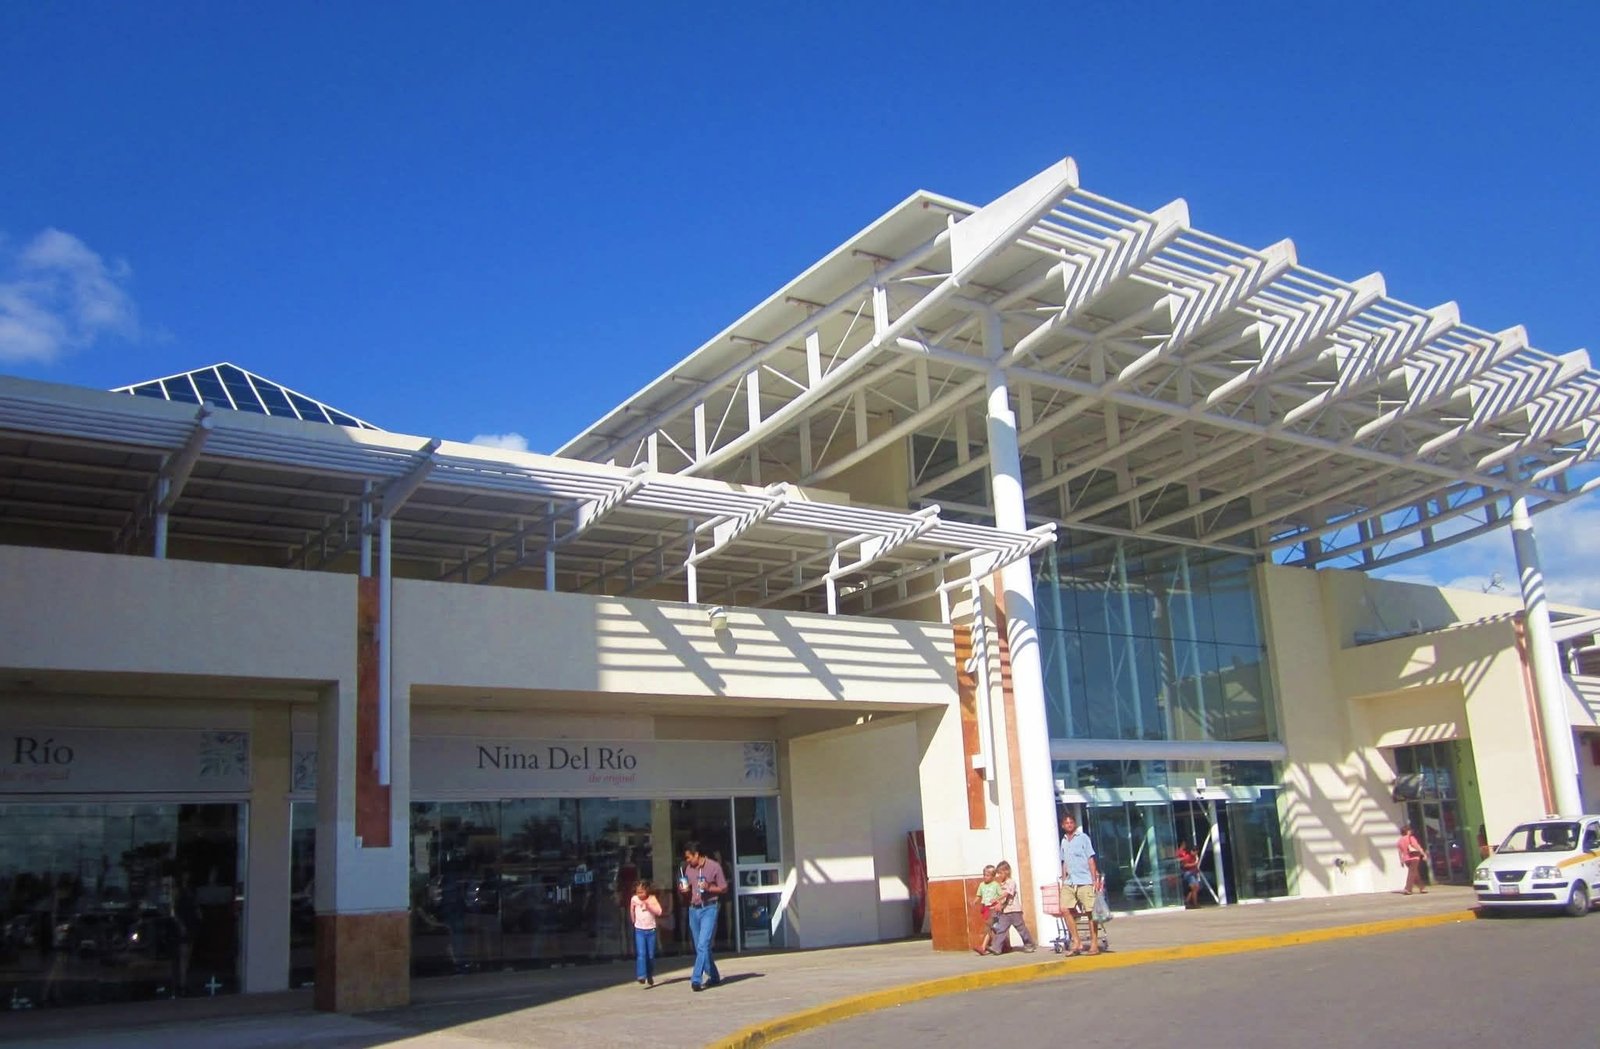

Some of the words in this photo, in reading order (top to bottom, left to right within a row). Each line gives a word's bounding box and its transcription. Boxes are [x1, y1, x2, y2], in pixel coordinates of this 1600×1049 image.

[12, 737, 74, 765] Río
[476, 745, 540, 769] Nina
[547, 746, 590, 770] Del
[597, 747, 637, 770] Río
